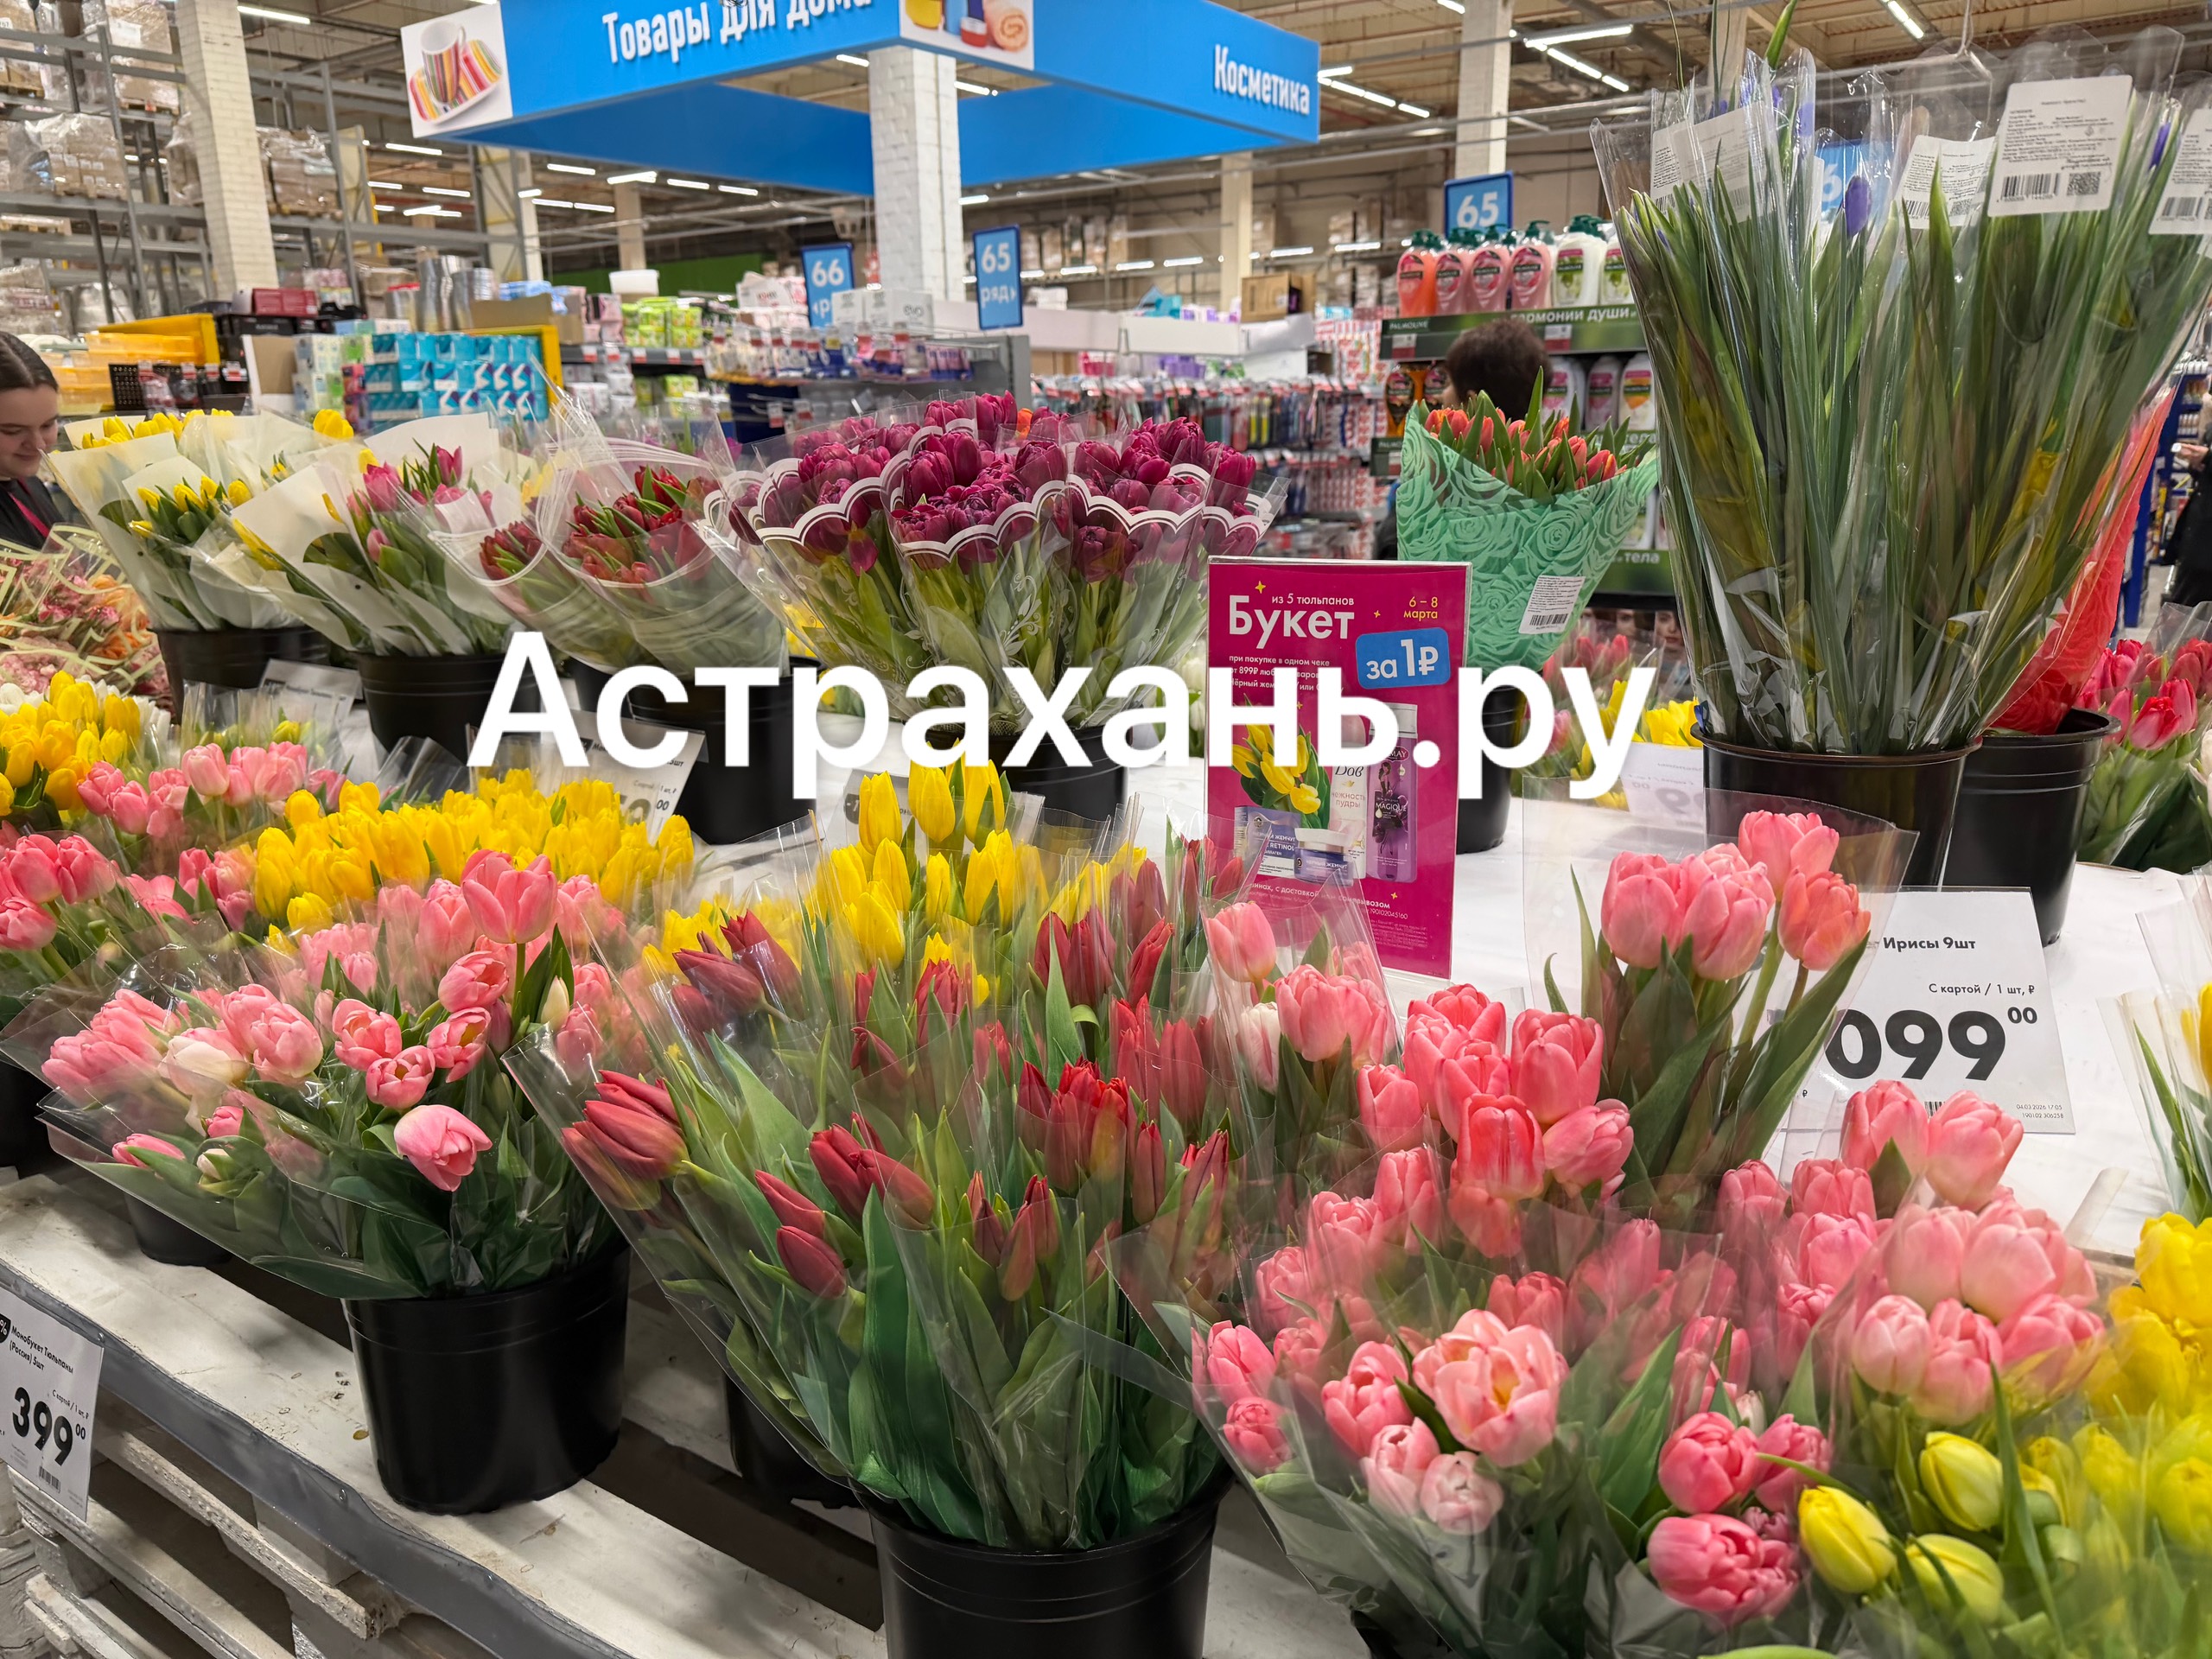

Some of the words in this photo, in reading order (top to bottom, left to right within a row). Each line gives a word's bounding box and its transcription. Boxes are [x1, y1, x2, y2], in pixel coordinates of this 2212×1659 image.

[602, 3, 711, 63] Товары
[1213, 43, 1311, 115] Косметика
[1456, 191, 1499, 228] 65
[981, 242, 1011, 274] 65
[811, 258, 845, 288] 66
[981, 285, 1010, 308] ряд
[1587, 307, 1630, 322] души
[1624, 551, 1660, 564] тела
[1272, 594, 1284, 604] из
[1287, 594, 1294, 604] 5
[1297, 595, 1354, 606] тюльпанов
[1408, 596, 1417, 607] 6
[1431, 596, 1439, 608] 8
[1229, 594, 1355, 649] Букет
[1403, 609, 1439, 621] марта
[1229, 655, 1243, 664] при
[1244, 657, 1276, 666] покупке
[1284, 658, 1310, 667] одном
[1239, 667, 1258, 676] 899₽
[1366, 659, 1398, 680] за
[657, 799, 670, 810] 00
[1336, 799, 1361, 810] пудры
[1376, 802, 1407, 812] MAGIQUE
[1281, 887, 1319, 899] доставкой
[1883, 937, 1940, 952] Ирисы
[1942, 937, 1976, 950] 9шт
[1929, 983, 1937, 994] С
[1941, 982, 1981, 996] картой
[1997, 984, 2003, 994] 1
[2007, 986, 2025, 996] шт,
[2007, 1007, 2037, 1024] 00
[10, 1340, 33, 1365] (Россия)
[33, 1357, 45, 1370] 5шт
[11, 1325, 43, 1353] Монобукет
[44, 1347, 73, 1374] Тюльпаны
[12, 1387, 73, 1466] 399
[75, 1423, 86, 1442] 00
